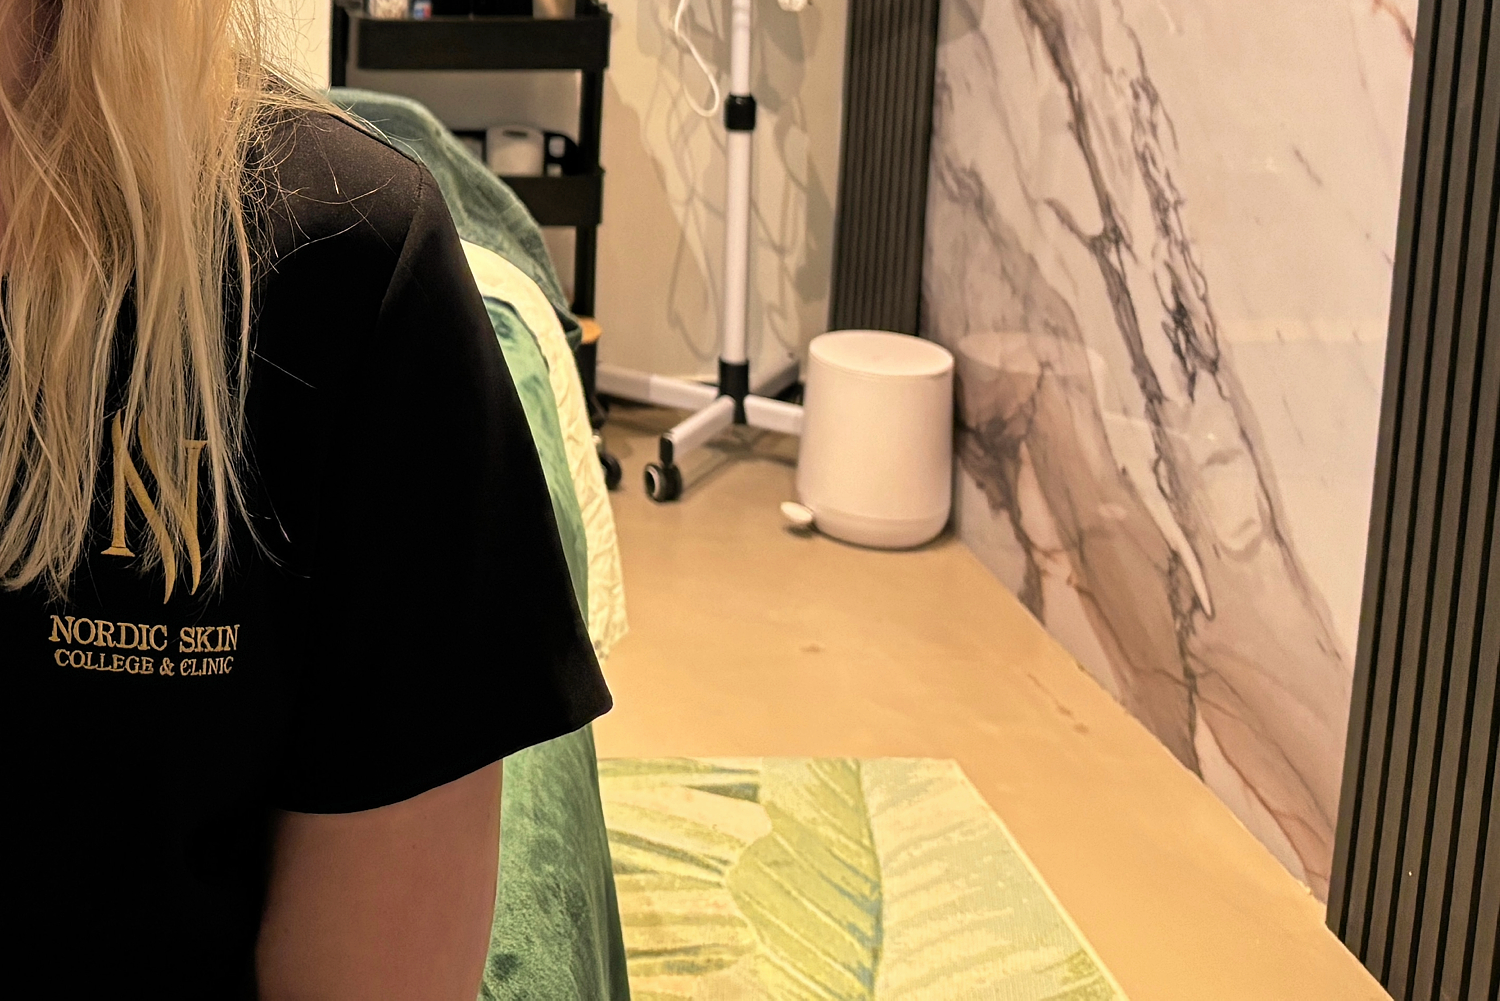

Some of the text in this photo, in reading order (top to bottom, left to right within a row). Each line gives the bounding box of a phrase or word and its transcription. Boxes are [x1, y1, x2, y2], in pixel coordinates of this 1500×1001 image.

[48, 614, 241, 653] NORDIC SKIN
[54, 648, 234, 676] COLLEGE & CLINIC
